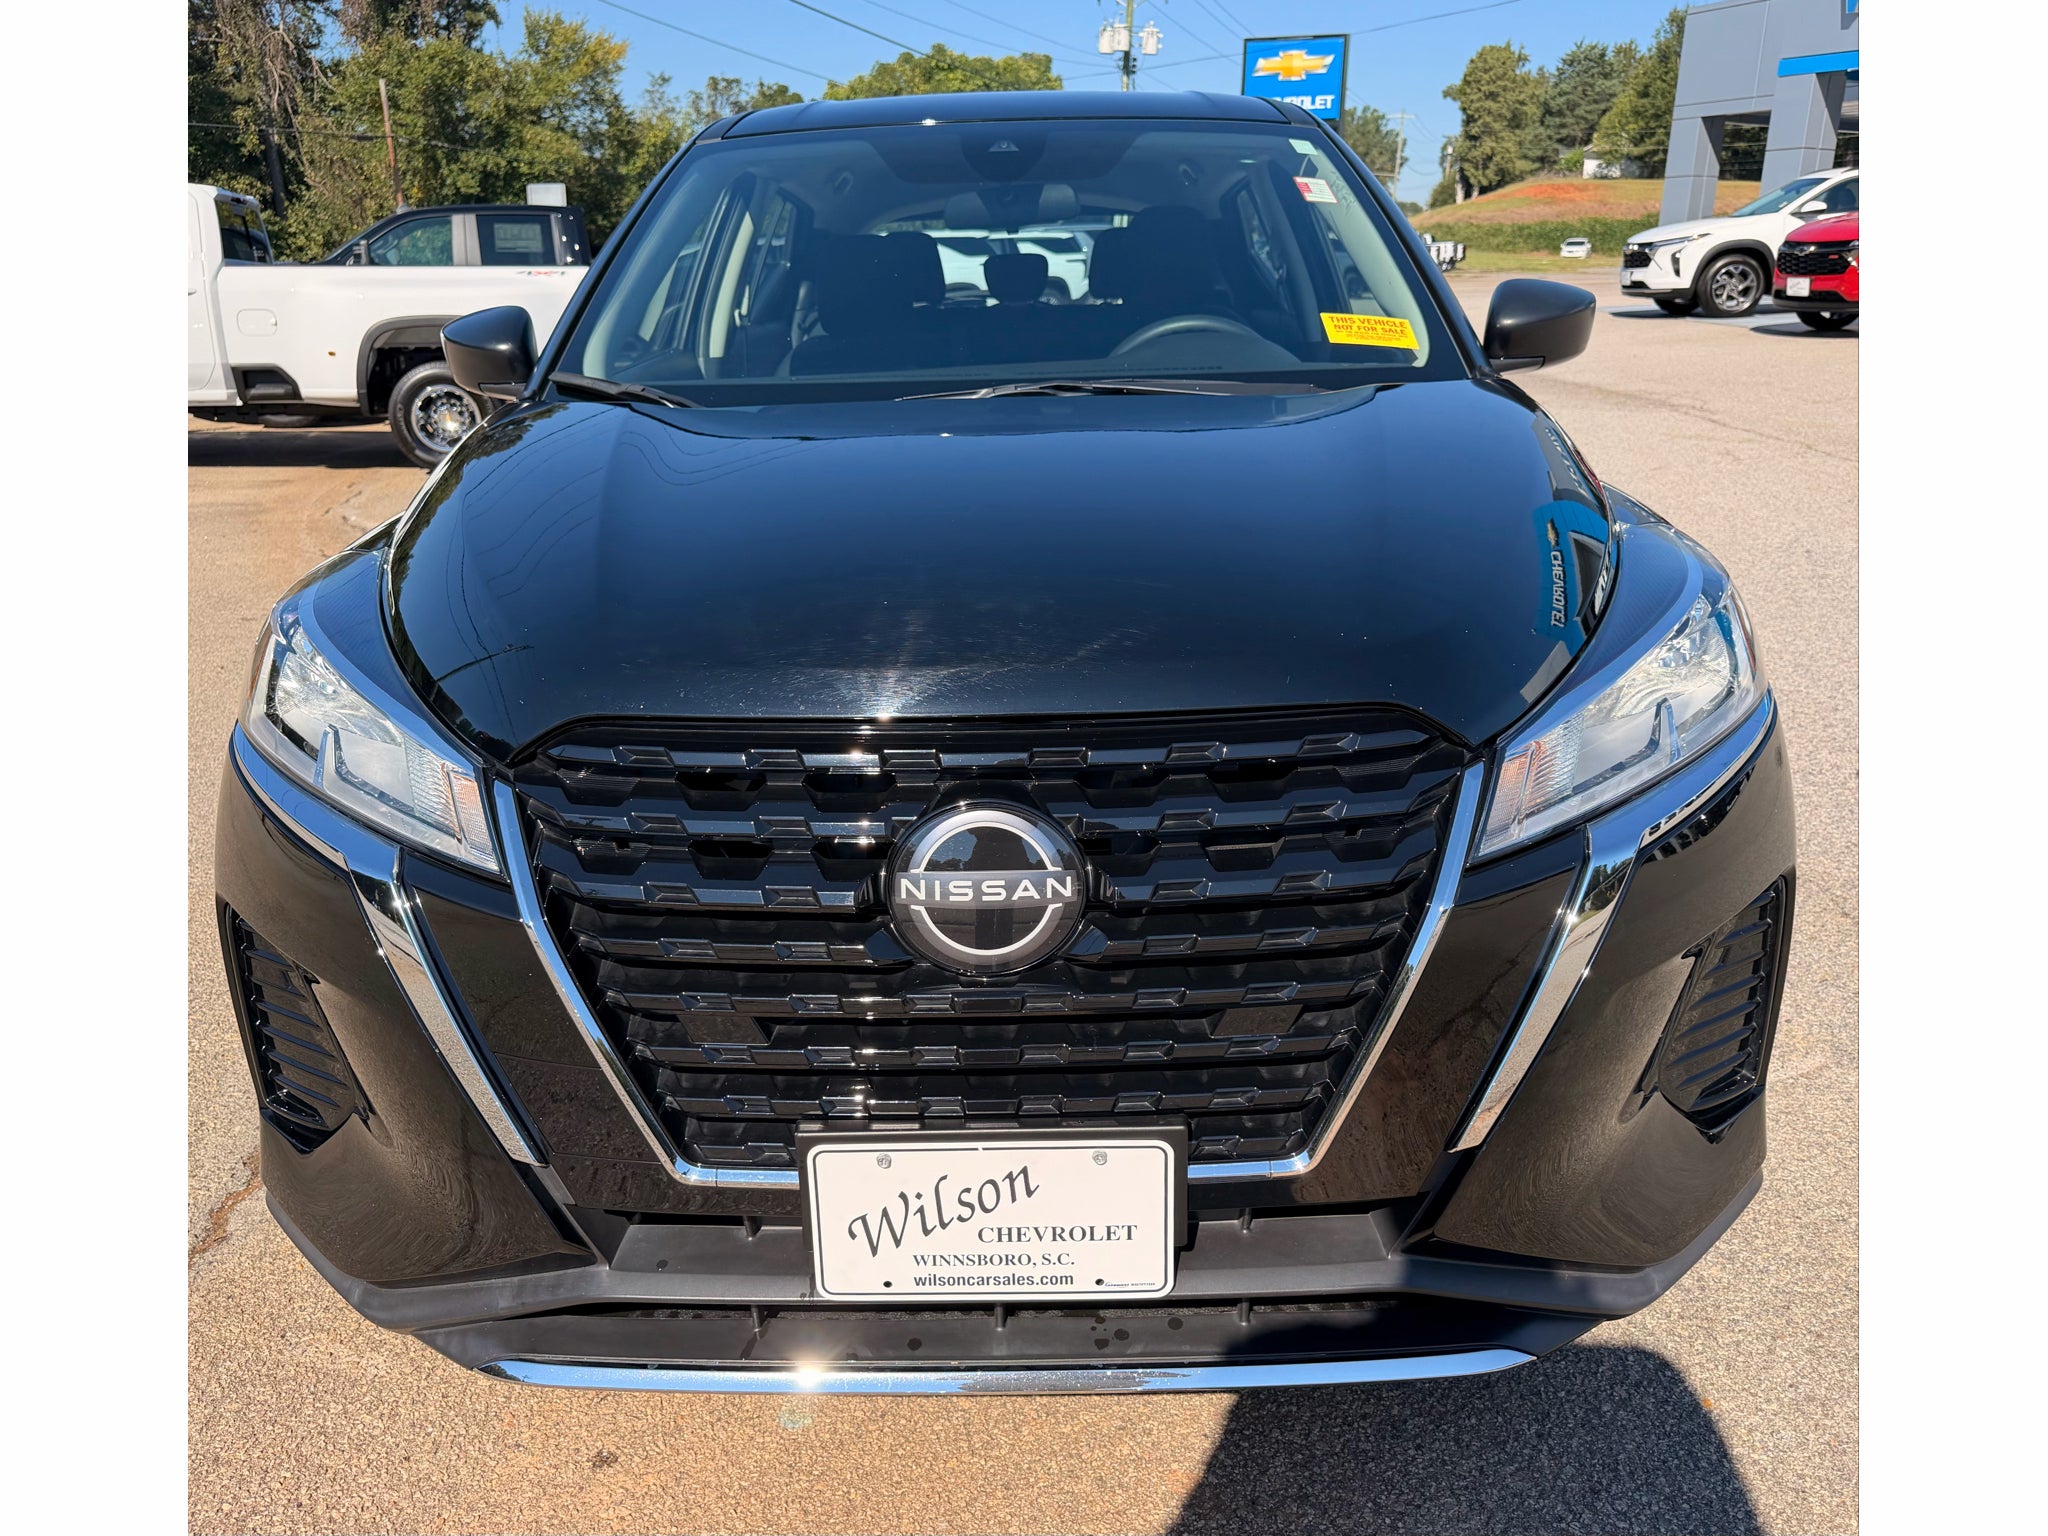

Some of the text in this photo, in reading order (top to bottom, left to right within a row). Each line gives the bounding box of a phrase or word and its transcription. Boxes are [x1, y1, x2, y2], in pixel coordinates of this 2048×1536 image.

[1328, 316, 1407, 329] THIS VEHICLE
[1381, 327, 1407, 335] SALE
[900, 876, 1072, 902] NISSAN
[847, 1164, 1040, 1258] Wilson
[977, 1224, 1138, 1244] CHEVROLET
[912, 1252, 1075, 1268] WINNSBORO, S.C.
[913, 1272, 1074, 1287] wilsoncarsales.com
